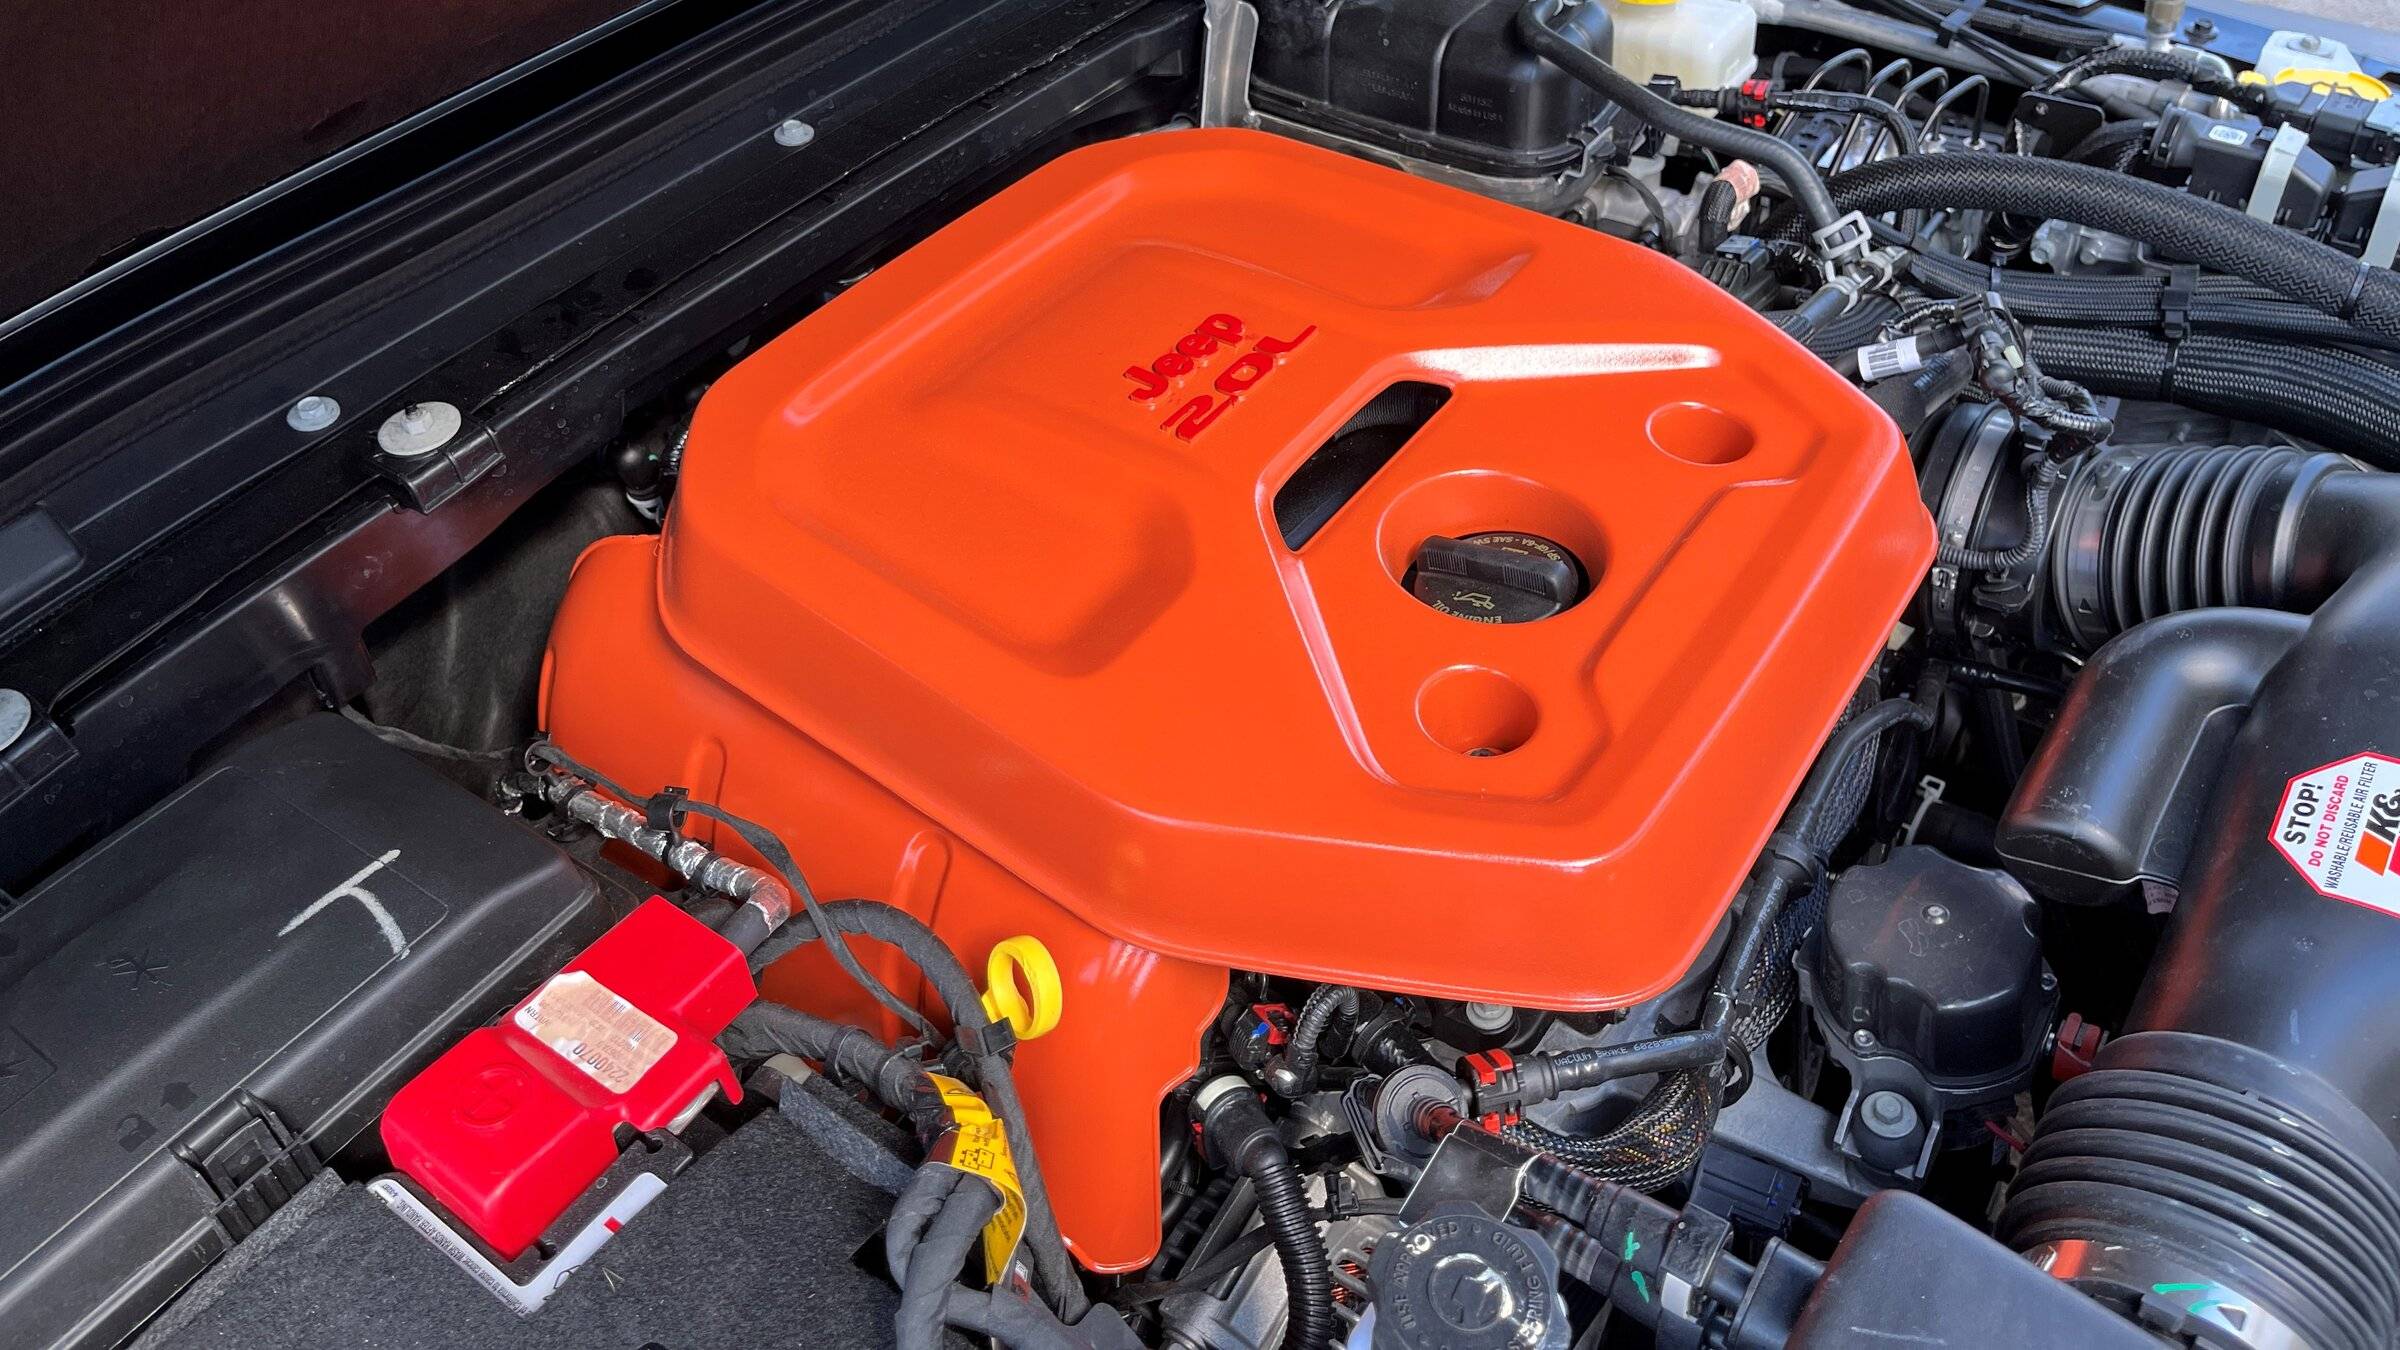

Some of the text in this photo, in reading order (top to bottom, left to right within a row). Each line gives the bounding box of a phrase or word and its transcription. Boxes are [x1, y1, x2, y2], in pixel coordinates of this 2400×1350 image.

[1123, 313, 1245, 401] Jeep
[2283, 782, 2324, 845] STOP!
[2308, 775, 2349, 867] DO NOT DISCARD
[2324, 762, 2378, 889] WASHABLE/REUSABLE AIR FILTER
[1491, 1231, 1535, 1273] FLUID
